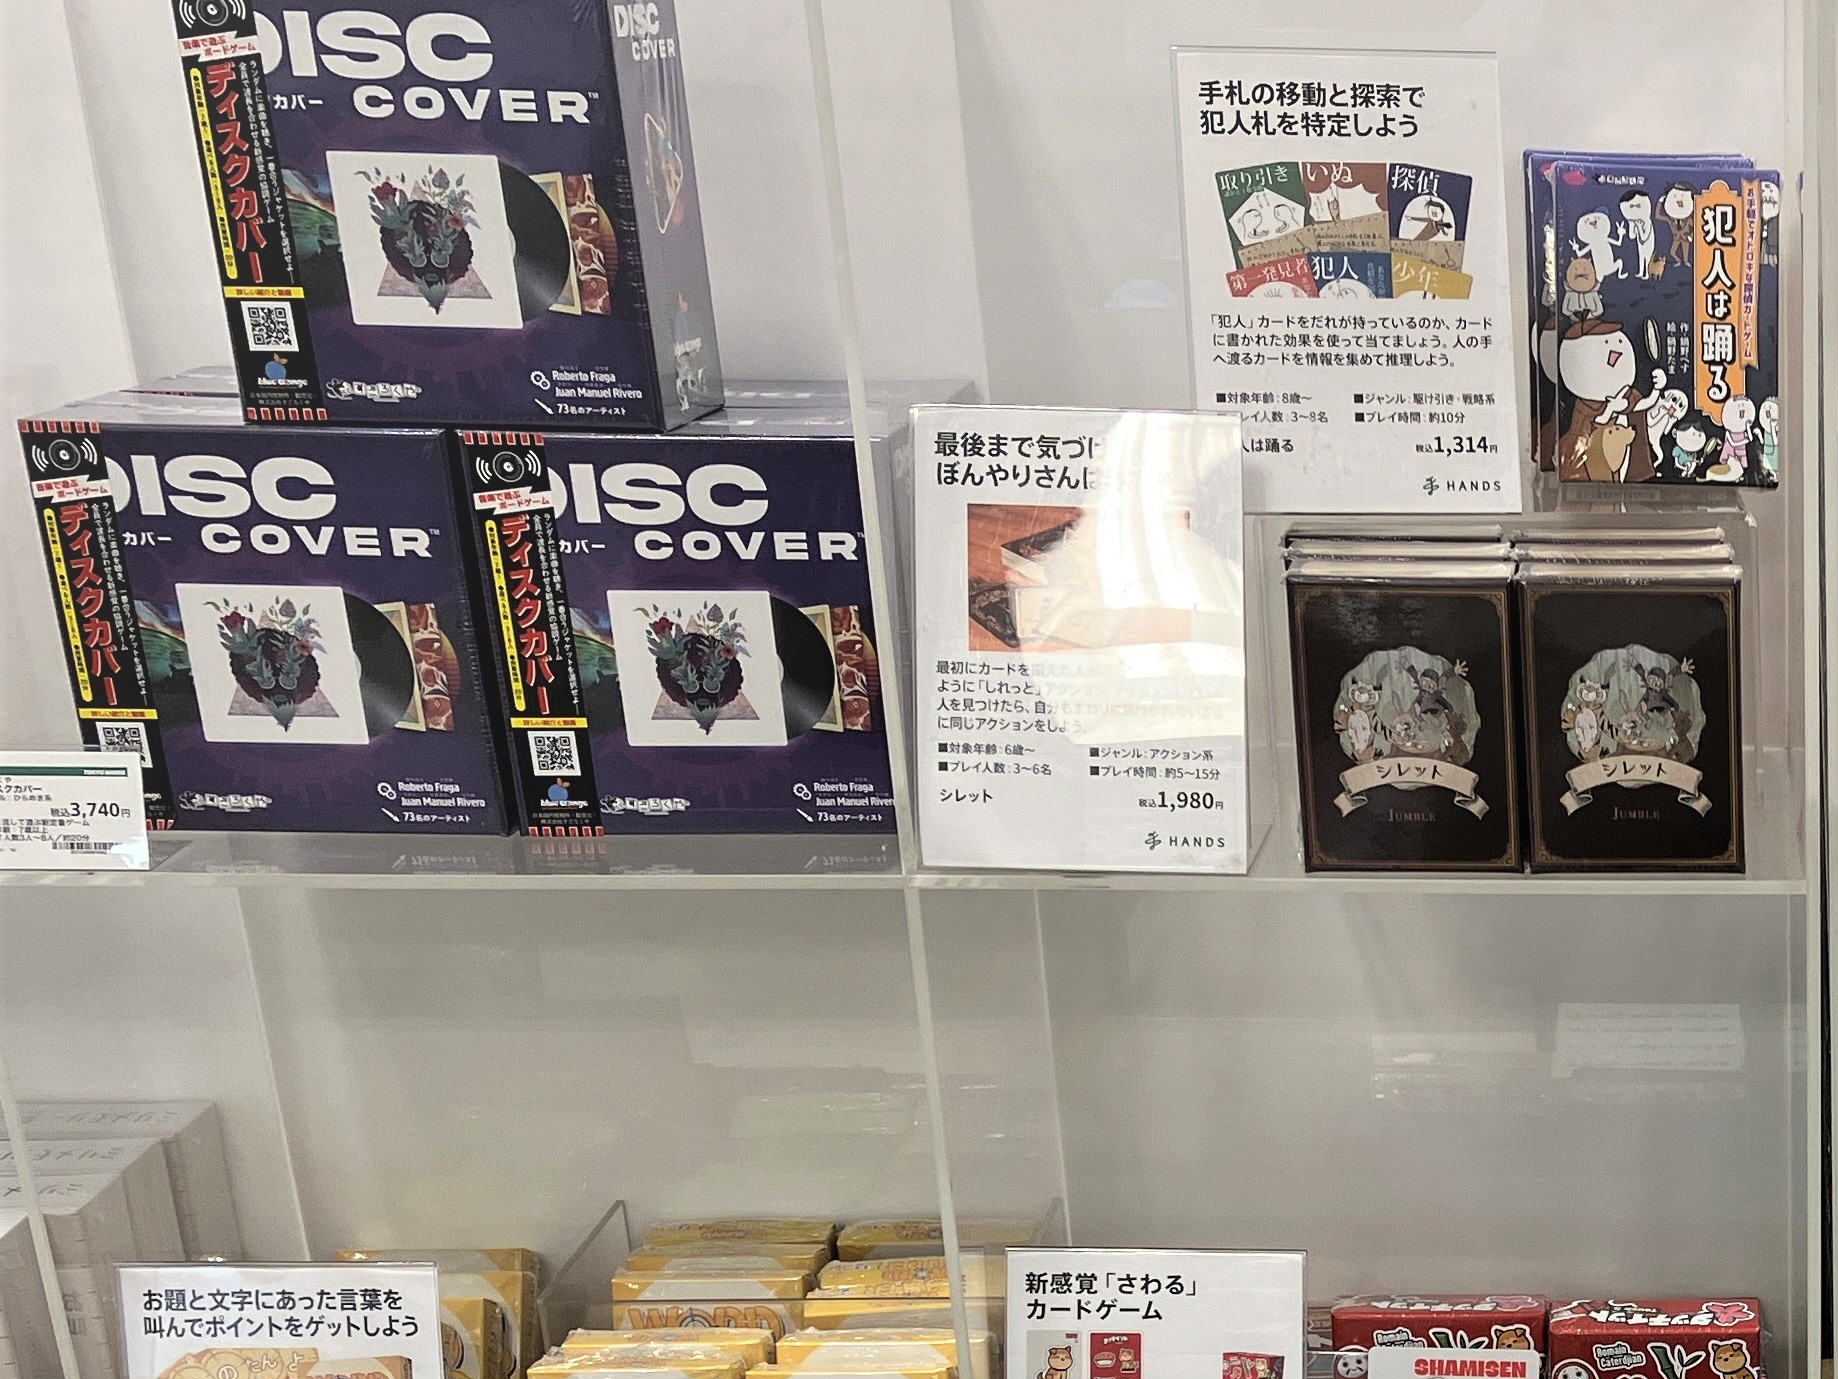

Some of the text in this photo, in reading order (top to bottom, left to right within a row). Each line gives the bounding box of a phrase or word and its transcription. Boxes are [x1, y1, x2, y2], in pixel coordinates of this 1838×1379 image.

[352, 85, 590, 124] COVER
[1200, 81, 1425, 110] 手札の移動と探索で
[1200, 112, 1418, 138] 犯人札を特定しよう
[205, 61, 264, 284] ディスクカバー
[1702, 204, 1736, 402] 犯人は踊る
[1210, 316, 1493, 331] 「犯人」カードをだれが持っているのか、カード
[1213, 334, 1493, 350] に書かれた効果を使って当てましょう。人の手
[1213, 352, 1457, 369] へ渡るカードを情報を集めて推理しよう。
[552, 371, 616, 383] Roberto Fraga
[1415, 435, 1498, 456] 税込1,314円
[1446, 479, 1501, 493] HANDS
[202, 525, 433, 560] COVER
[636, 528, 861, 561] COVER
[60, 502, 116, 708] ディスクカバー
[501, 515, 551, 716] ディスクカバー
[1376, 763, 1443, 780] シレット
[1601, 761, 1668, 777] シレット
[50, 802, 131, 818] 税込3,740円
[940, 788, 1224, 812] シレット 税込1,980円
[1170, 836, 1225, 848] HANDS
[1025, 1272, 1197, 1296] 新感覚「さわる」
[143, 1288, 402, 1312] お題と文字にあった言葉を
[1027, 1299, 1163, 1321] カードゲーム
[143, 1314, 419, 1338] 叫んでポイントをゲットしよう
[1414, 1359, 1527, 1379] SHAMISEN
